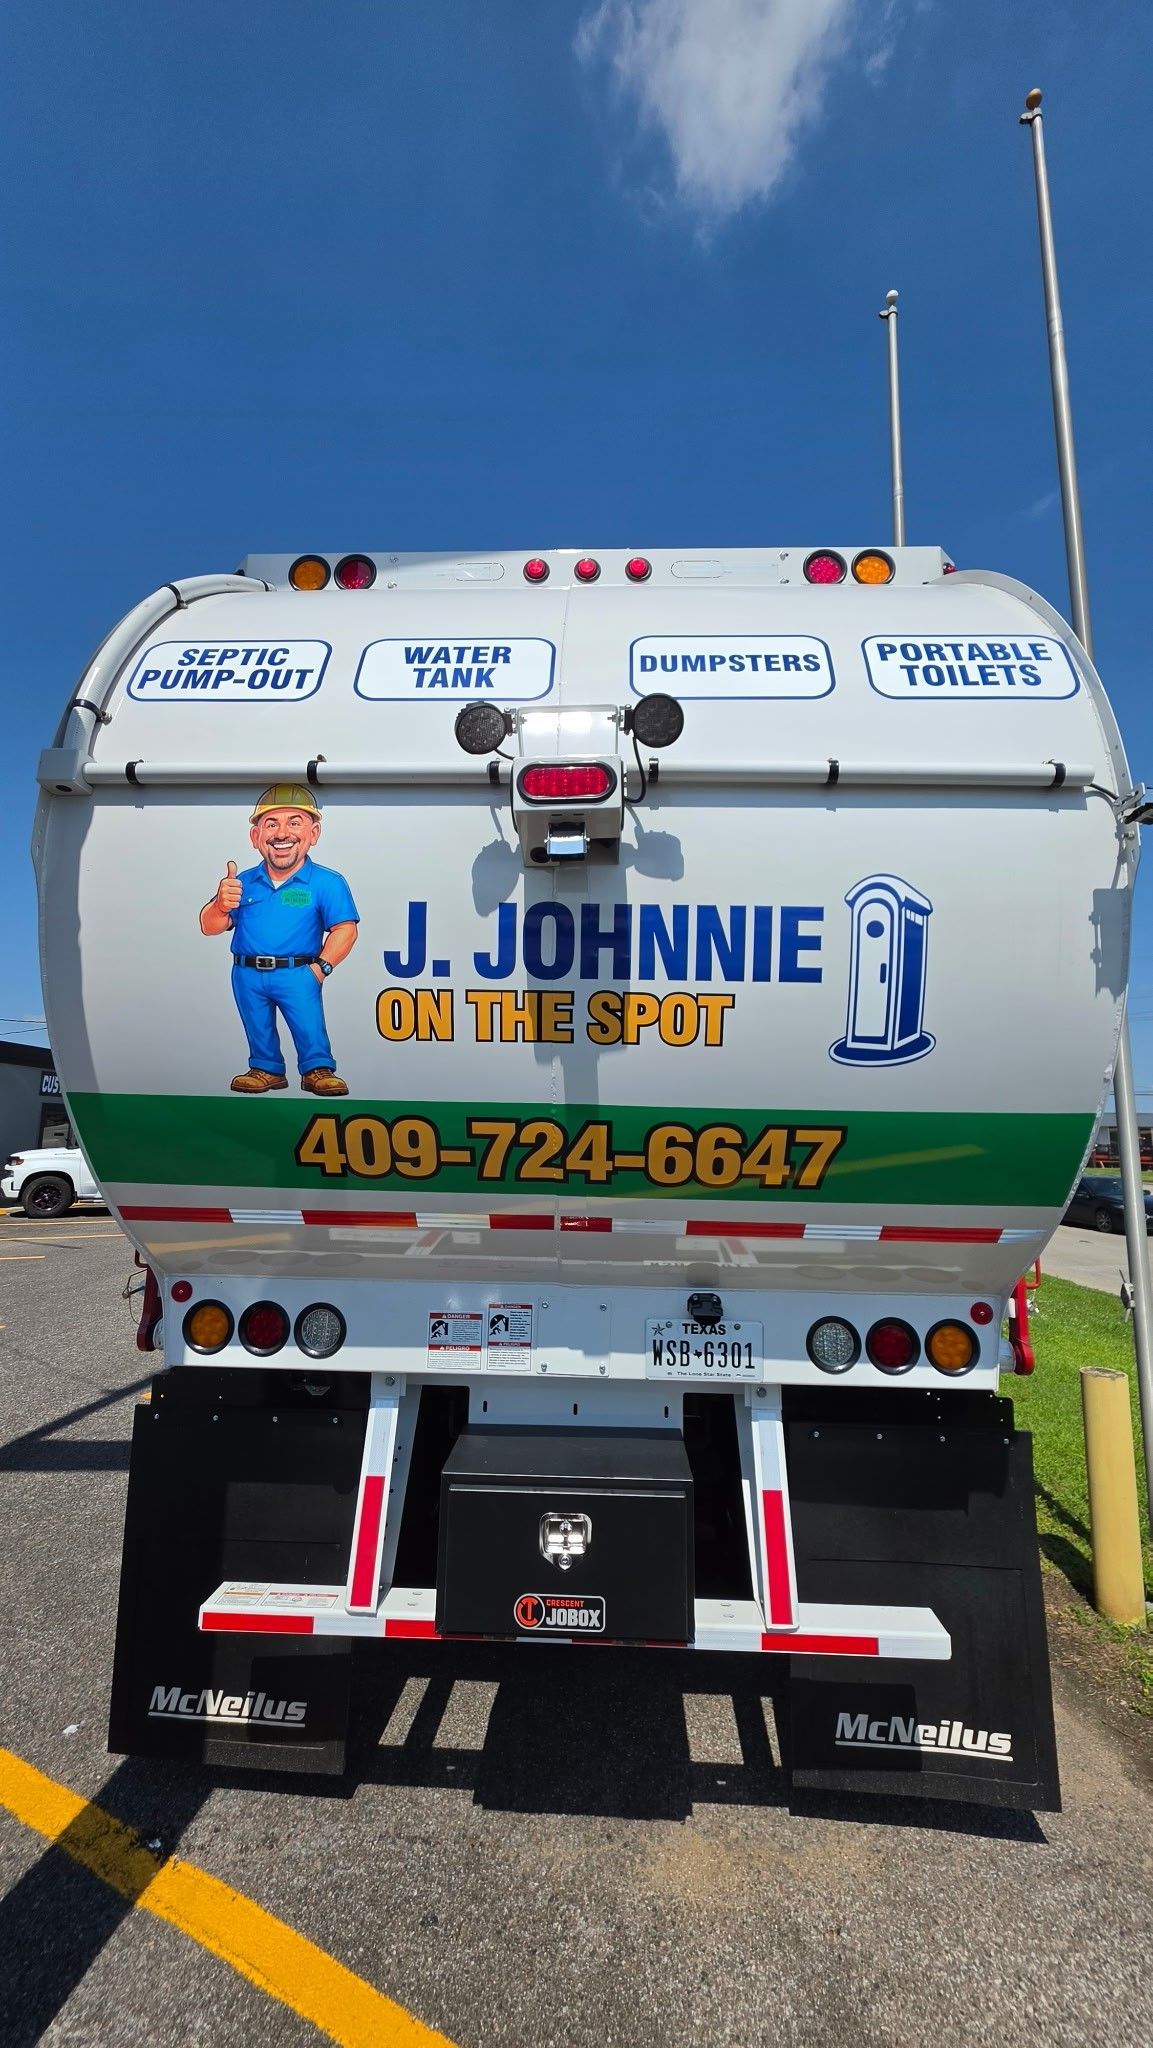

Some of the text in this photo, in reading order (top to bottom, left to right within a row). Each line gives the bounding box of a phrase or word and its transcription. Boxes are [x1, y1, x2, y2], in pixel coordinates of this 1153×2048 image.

[177, 647, 290, 666] SEPTIC
[404, 646, 512, 664] WATER
[876, 642, 1053, 661] PORTABLE
[639, 653, 821, 673] DUMPSTERS
[137, 668, 314, 690] PUMP-OUT
[413, 667, 495, 688] TANK
[899, 664, 1042, 687] TOILETS
[383, 900, 824, 983] J. JOHNNIE
[376, 986, 735, 1047] ON THE SPOT
[42, 1075, 61, 1093] CUS
[295, 1113, 848, 1190] 409-724-6647
[682, 1323, 727, 1335] TEXAS
[652, 1339, 755, 1369] WSB 6301
[546, 1600, 585, 1608] CRESCENT
[546, 1608, 601, 1627] JOBOX
[150, 1685, 308, 1721] McNeilus
[835, 1712, 1012, 1754] McNeilus
